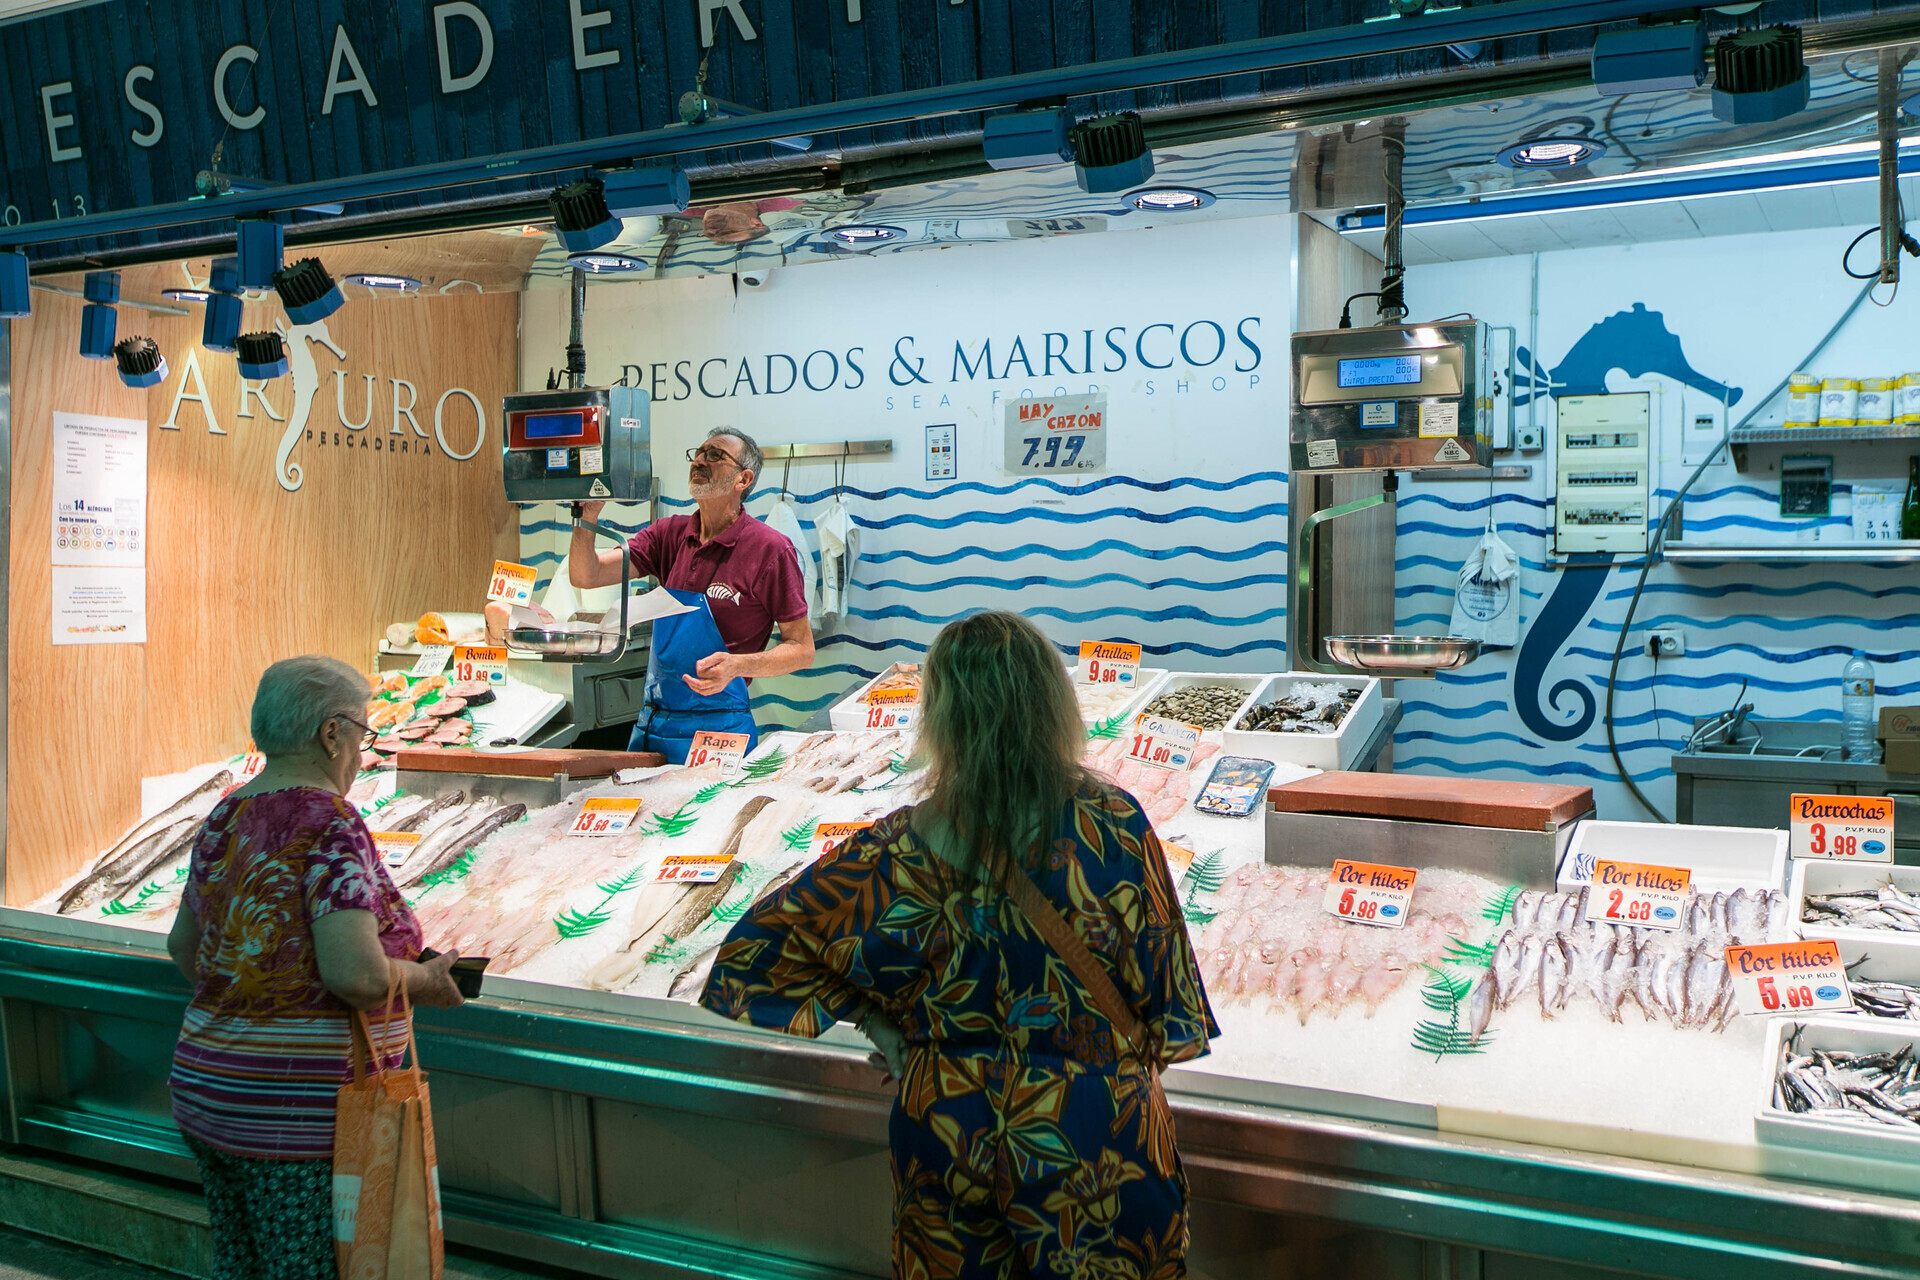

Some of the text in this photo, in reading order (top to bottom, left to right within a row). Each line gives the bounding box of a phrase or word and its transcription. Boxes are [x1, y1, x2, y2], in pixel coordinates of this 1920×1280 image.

[621, 317, 1262, 402] PESCADOS & MARISCOS
[886, 394, 951, 411] SEA
[1146, 375, 1260, 395] SHOP
[1019, 403, 1054, 420] HAY
[1047, 405, 1101, 429] CAZÓN
[306, 429, 431, 456] PESCADERÍA
[1022, 436, 1086, 468] 7.99
[74, 499, 84, 511] 14
[466, 649, 496, 661] Bonito
[1089, 645, 1133, 660] Anillas
[1089, 660, 1116, 683] 9,98
[866, 707, 896, 728] 13,90
[701, 736, 737, 749] Rape
[1130, 733, 1171, 763] 11,90
[1801, 799, 1885, 820] Parrochas
[1810, 823, 1857, 857] 3,98
[1339, 865, 1409, 890] Por Kilos
[1602, 865, 1683, 891] Por Kilos
[1338, 888, 1377, 920] 5,98
[1606, 889, 1650, 920] 2,98
[1738, 950, 1833, 974] Por Kilos
[1756, 976, 1814, 1010] 5,99
